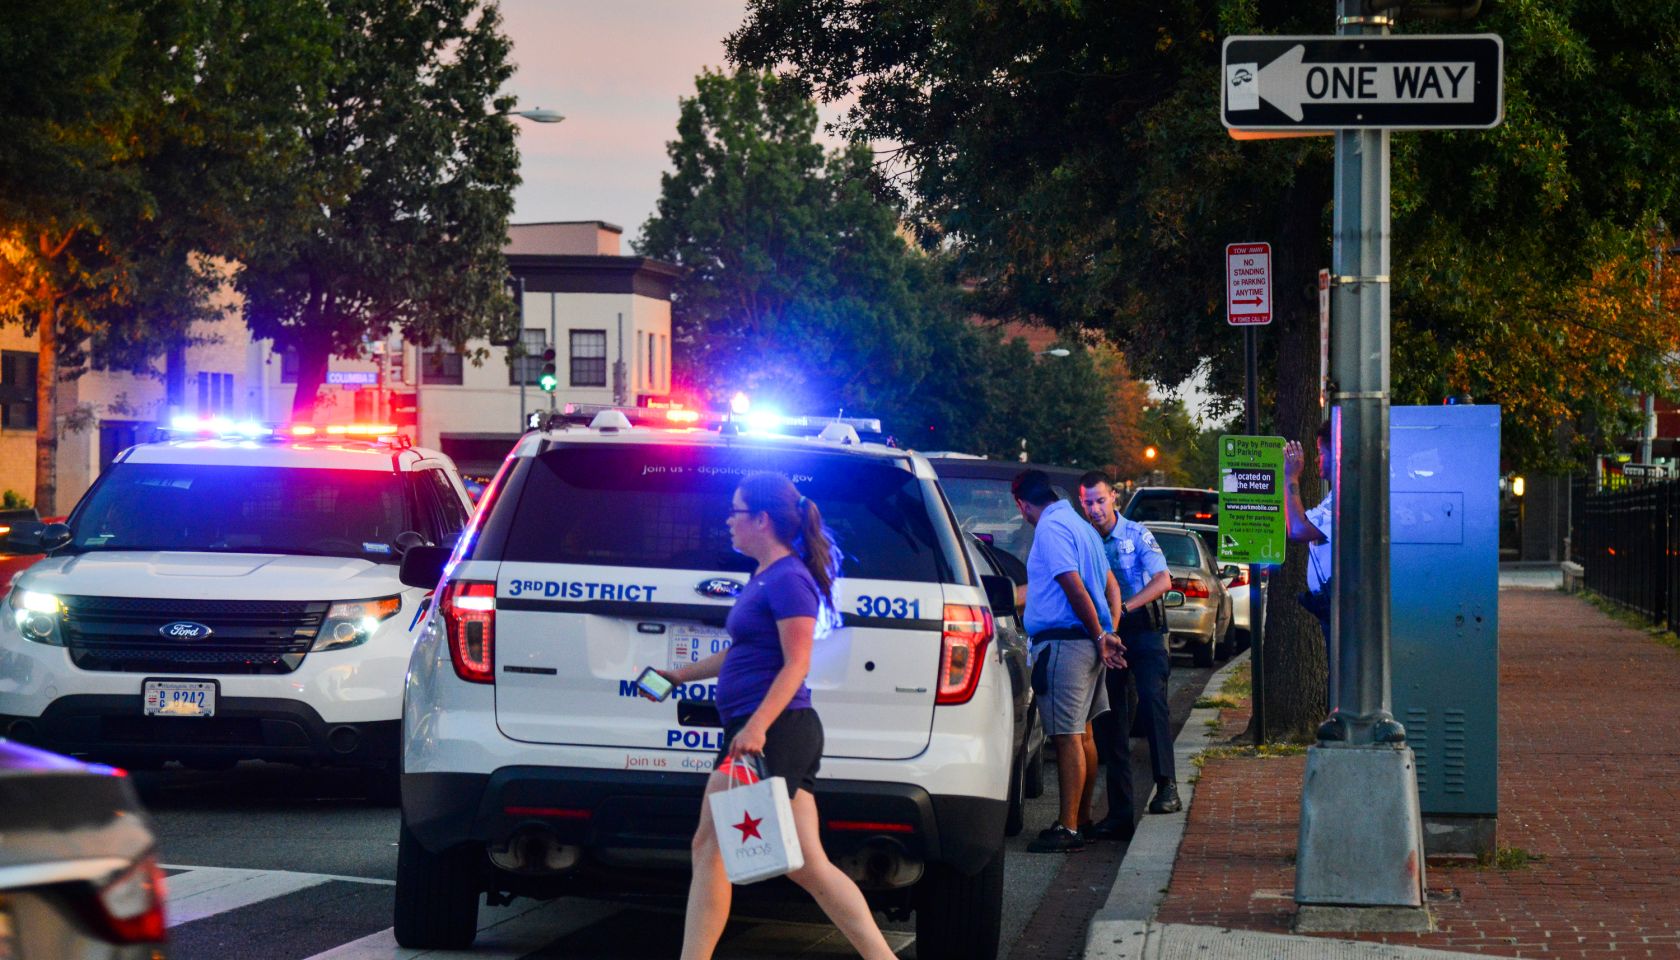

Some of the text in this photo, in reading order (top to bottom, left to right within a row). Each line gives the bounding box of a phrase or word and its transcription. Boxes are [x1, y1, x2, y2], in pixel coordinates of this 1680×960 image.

[1306, 65, 1470, 99] ONE WAY
[1234, 268, 1264, 276] STANDING
[1241, 278, 1265, 286] PARKING
[1236, 288, 1263, 296] ANYTIME
[1237, 439, 1281, 448] Pay by Phone
[1237, 448, 1262, 458] Parking
[642, 464, 666, 475] Join
[671, 464, 683, 473] us
[1234, 472, 1271, 481] Located on
[1249, 481, 1269, 490] Meter
[1226, 503, 1278, 511] www.parkmobile.com
[508, 578, 657, 602] 3RD DISTRICT
[856, 594, 920, 620] 3031
[170, 624, 200, 635] Ford
[173, 691, 205, 707] 8242
[624, 754, 649, 770] Join
[653, 758, 667, 767] us
